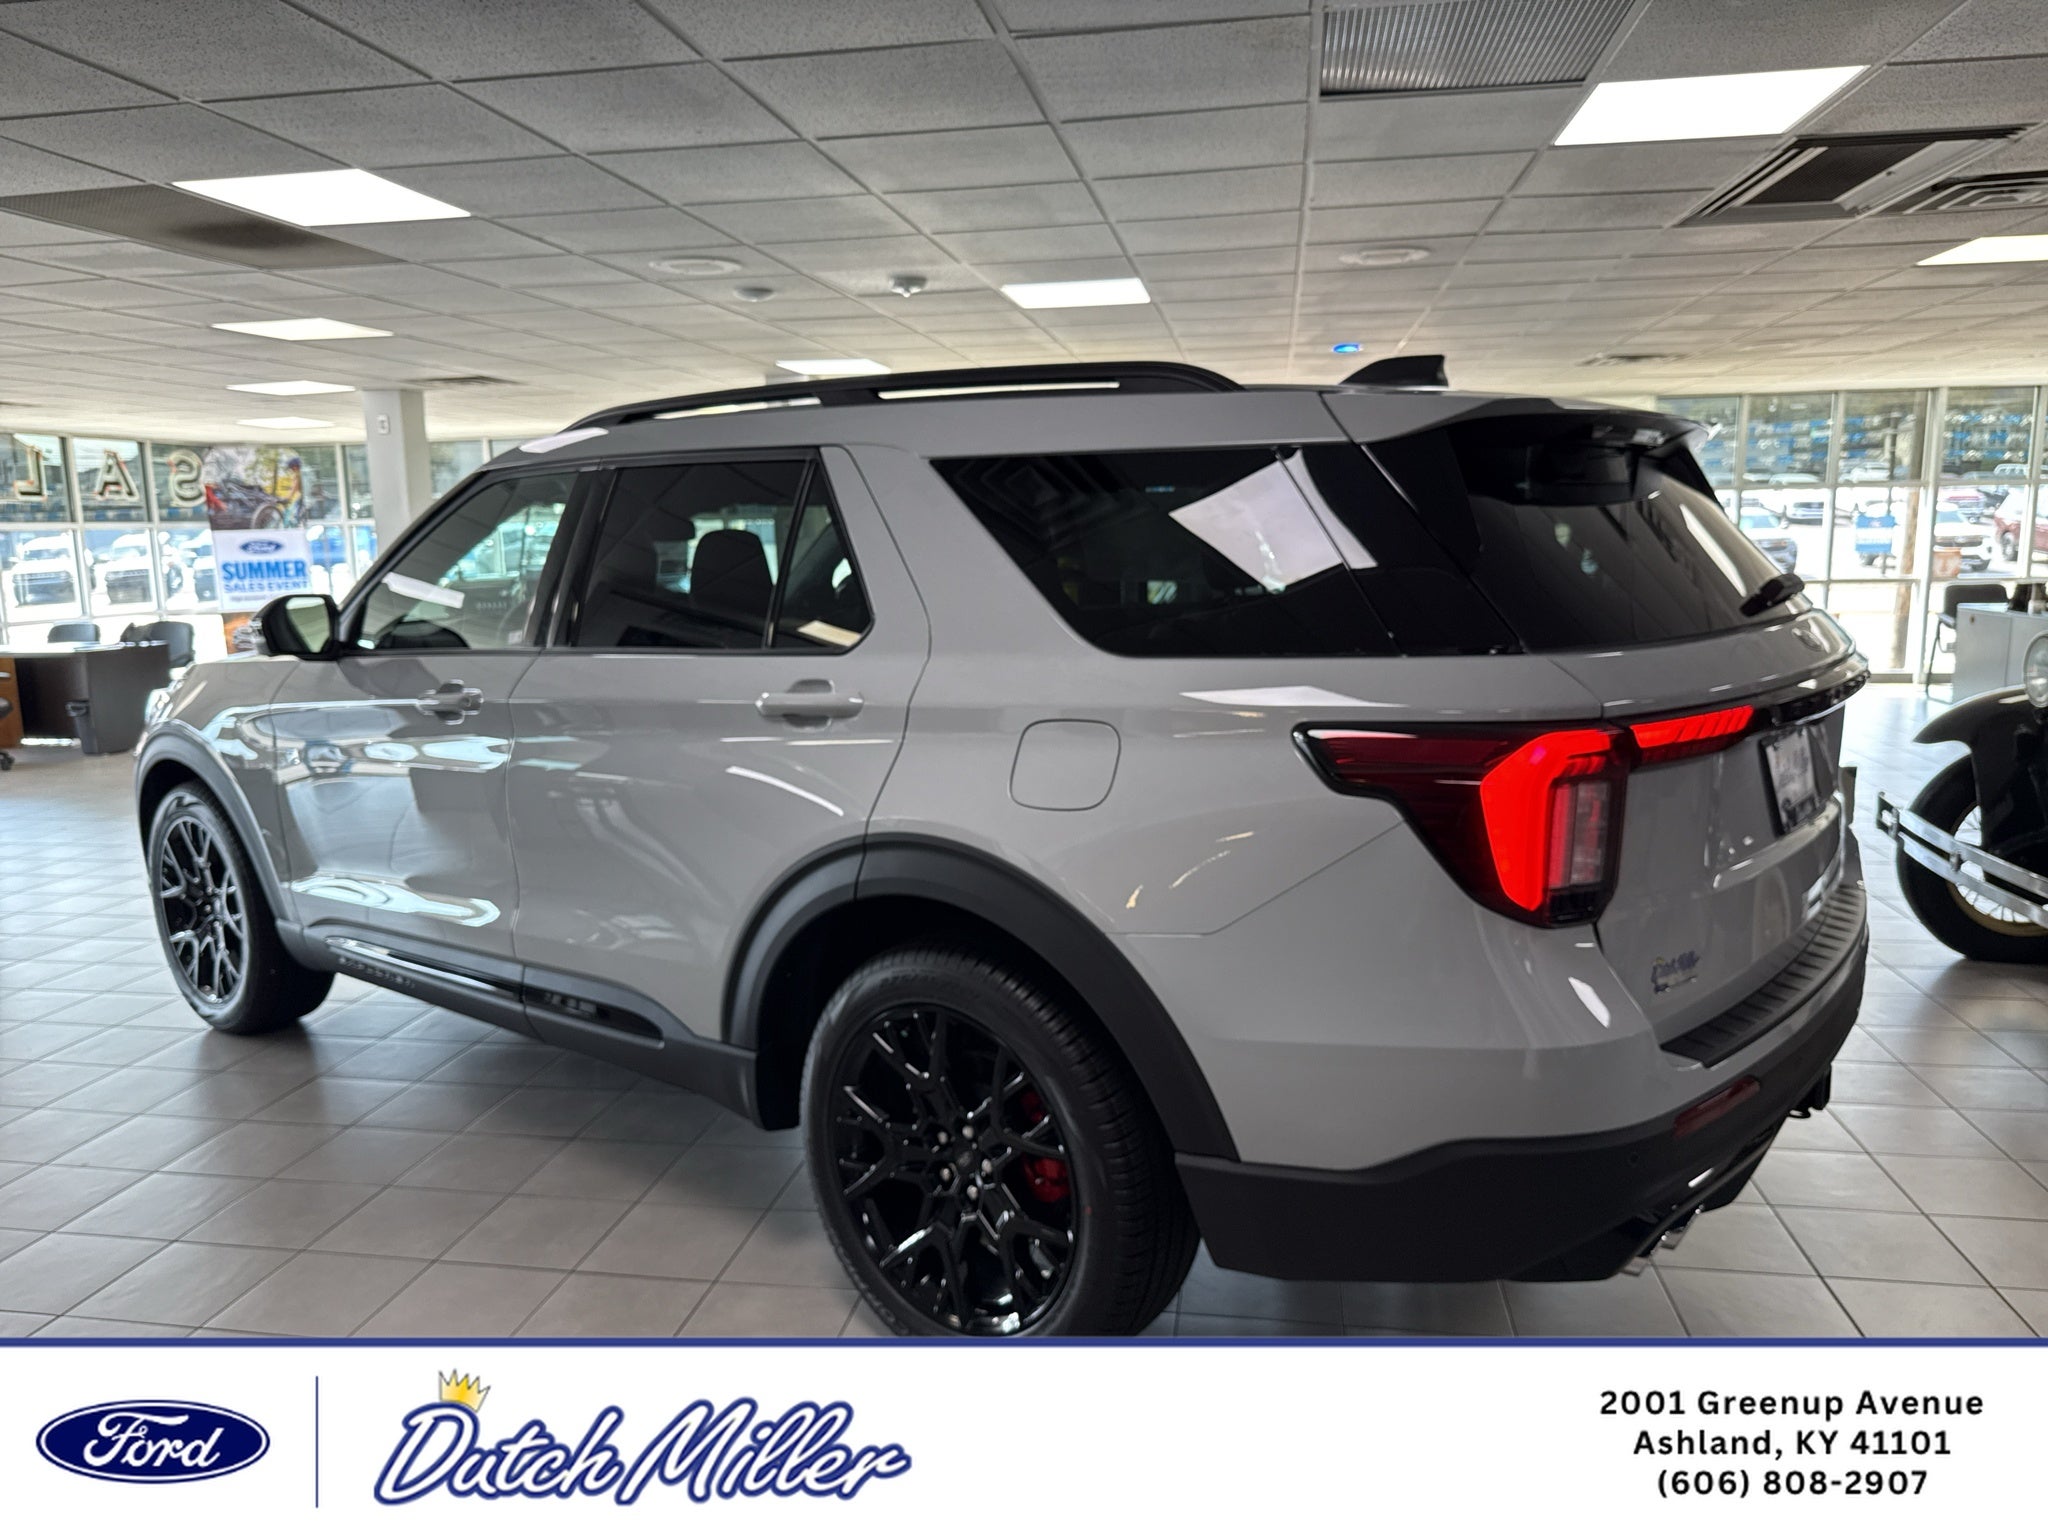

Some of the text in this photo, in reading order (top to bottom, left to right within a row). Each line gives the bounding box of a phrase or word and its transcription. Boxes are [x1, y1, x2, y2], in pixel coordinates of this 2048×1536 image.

[222, 560, 307, 581] SUMMER
[223, 580, 308, 593] SALES EVENT
